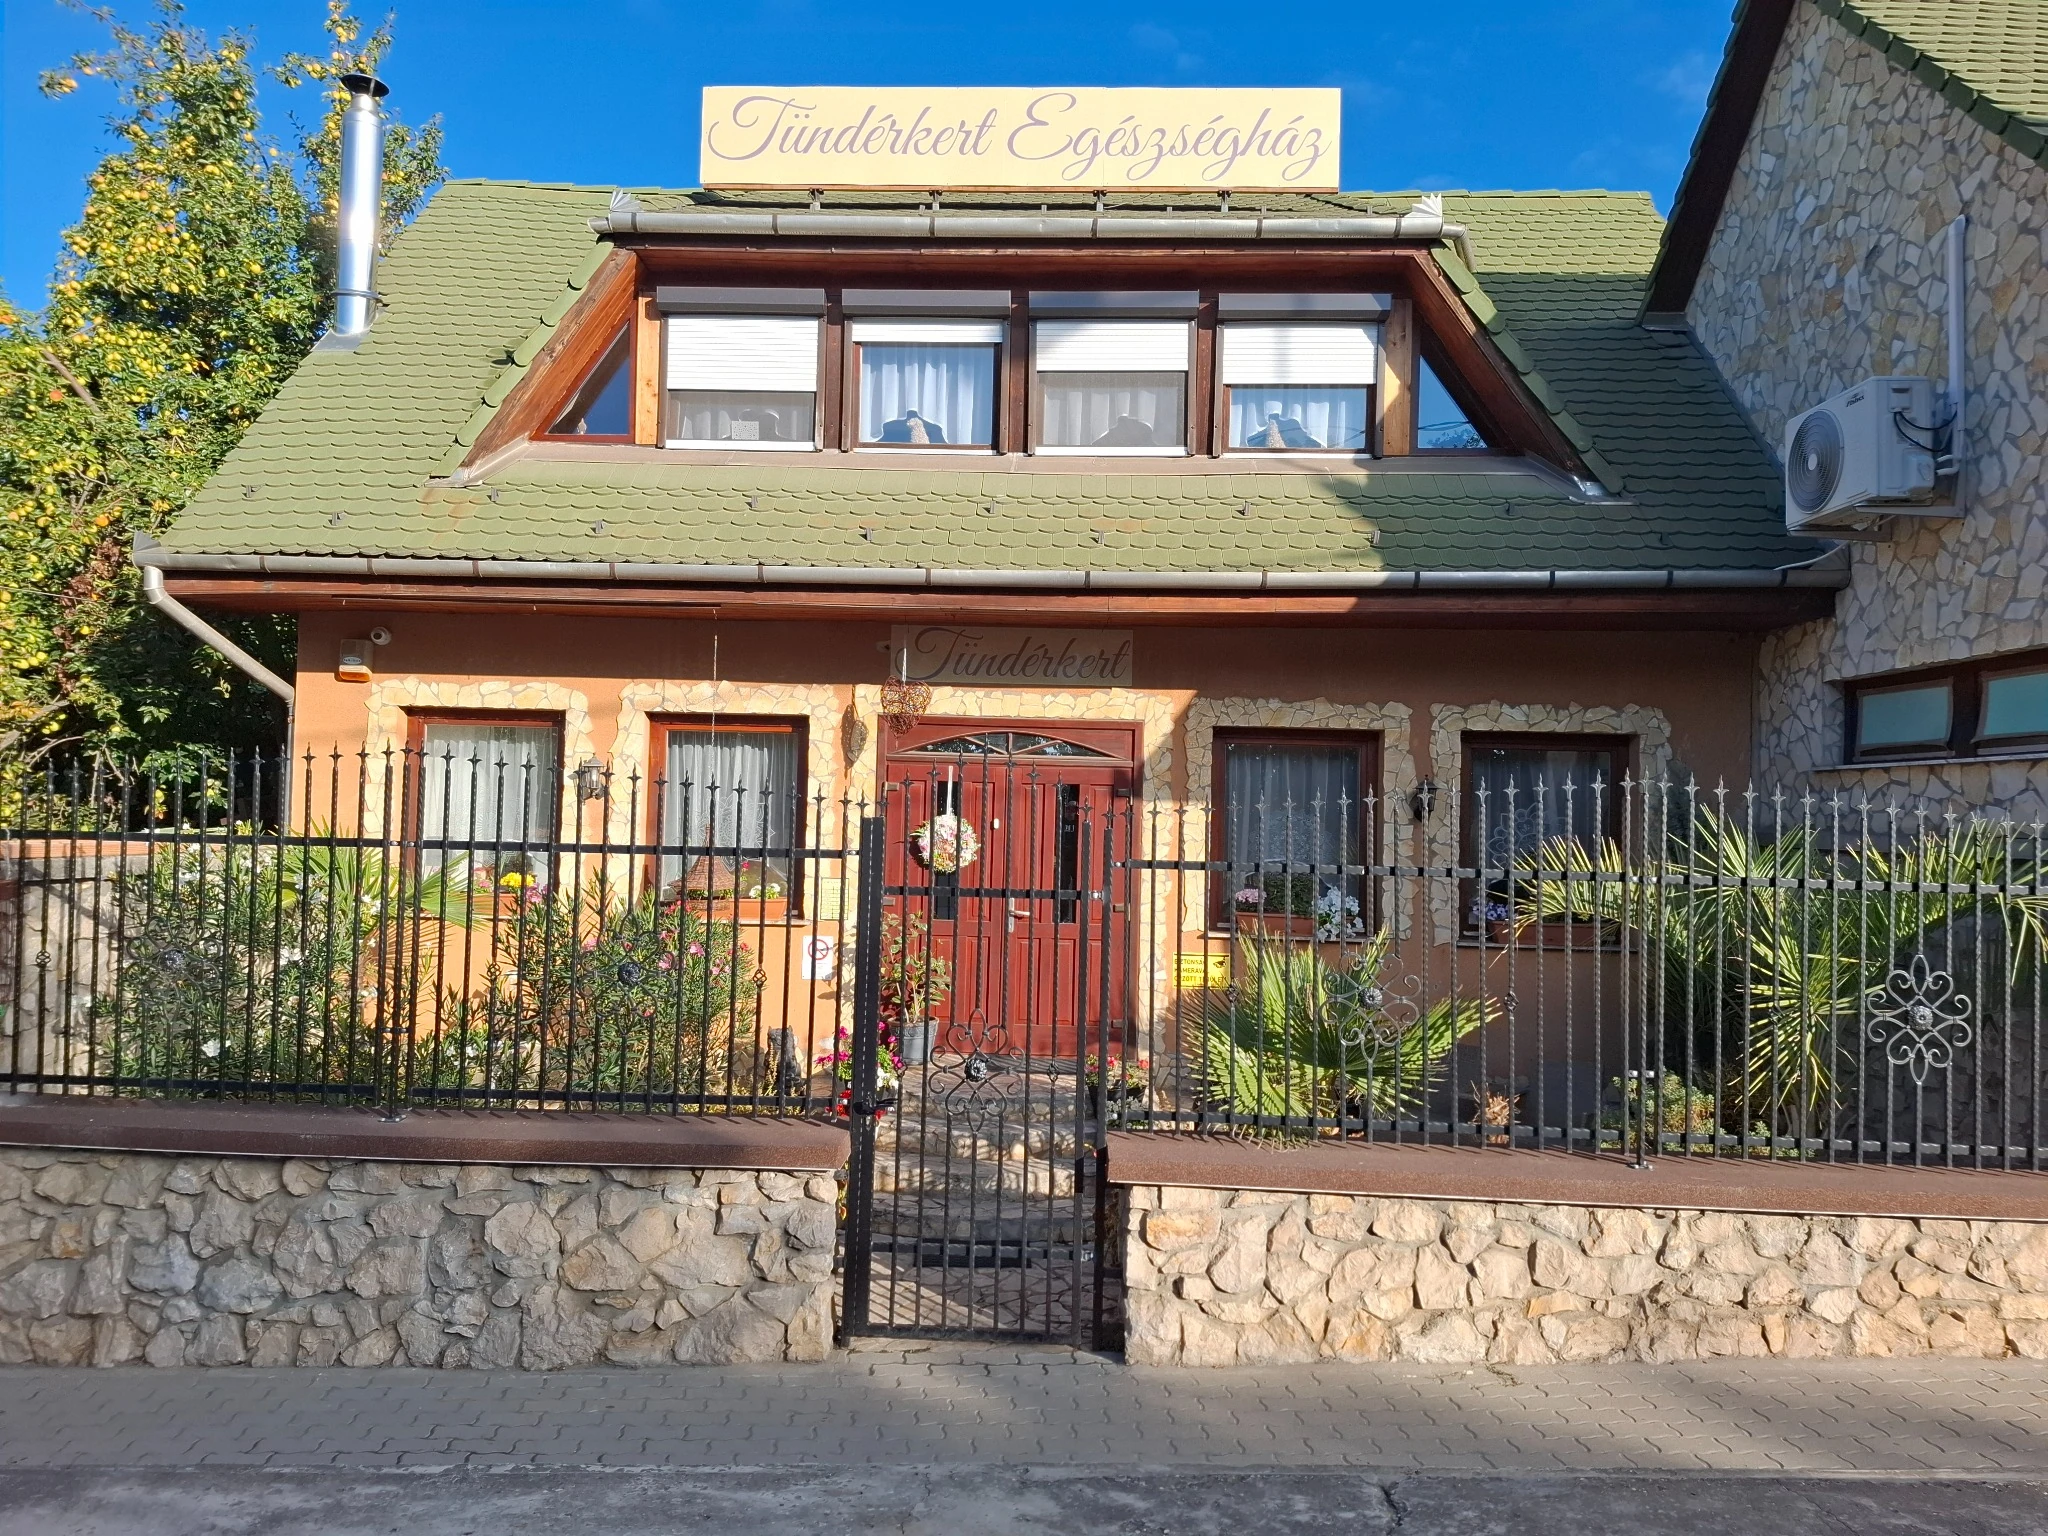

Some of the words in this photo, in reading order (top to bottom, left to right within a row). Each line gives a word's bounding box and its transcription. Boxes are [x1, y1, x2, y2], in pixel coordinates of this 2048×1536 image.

[708, 95, 998, 160] Tündérkert
[1007, 92, 1332, 181] Egészségház
[894, 626, 1131, 681] Tündérkert
